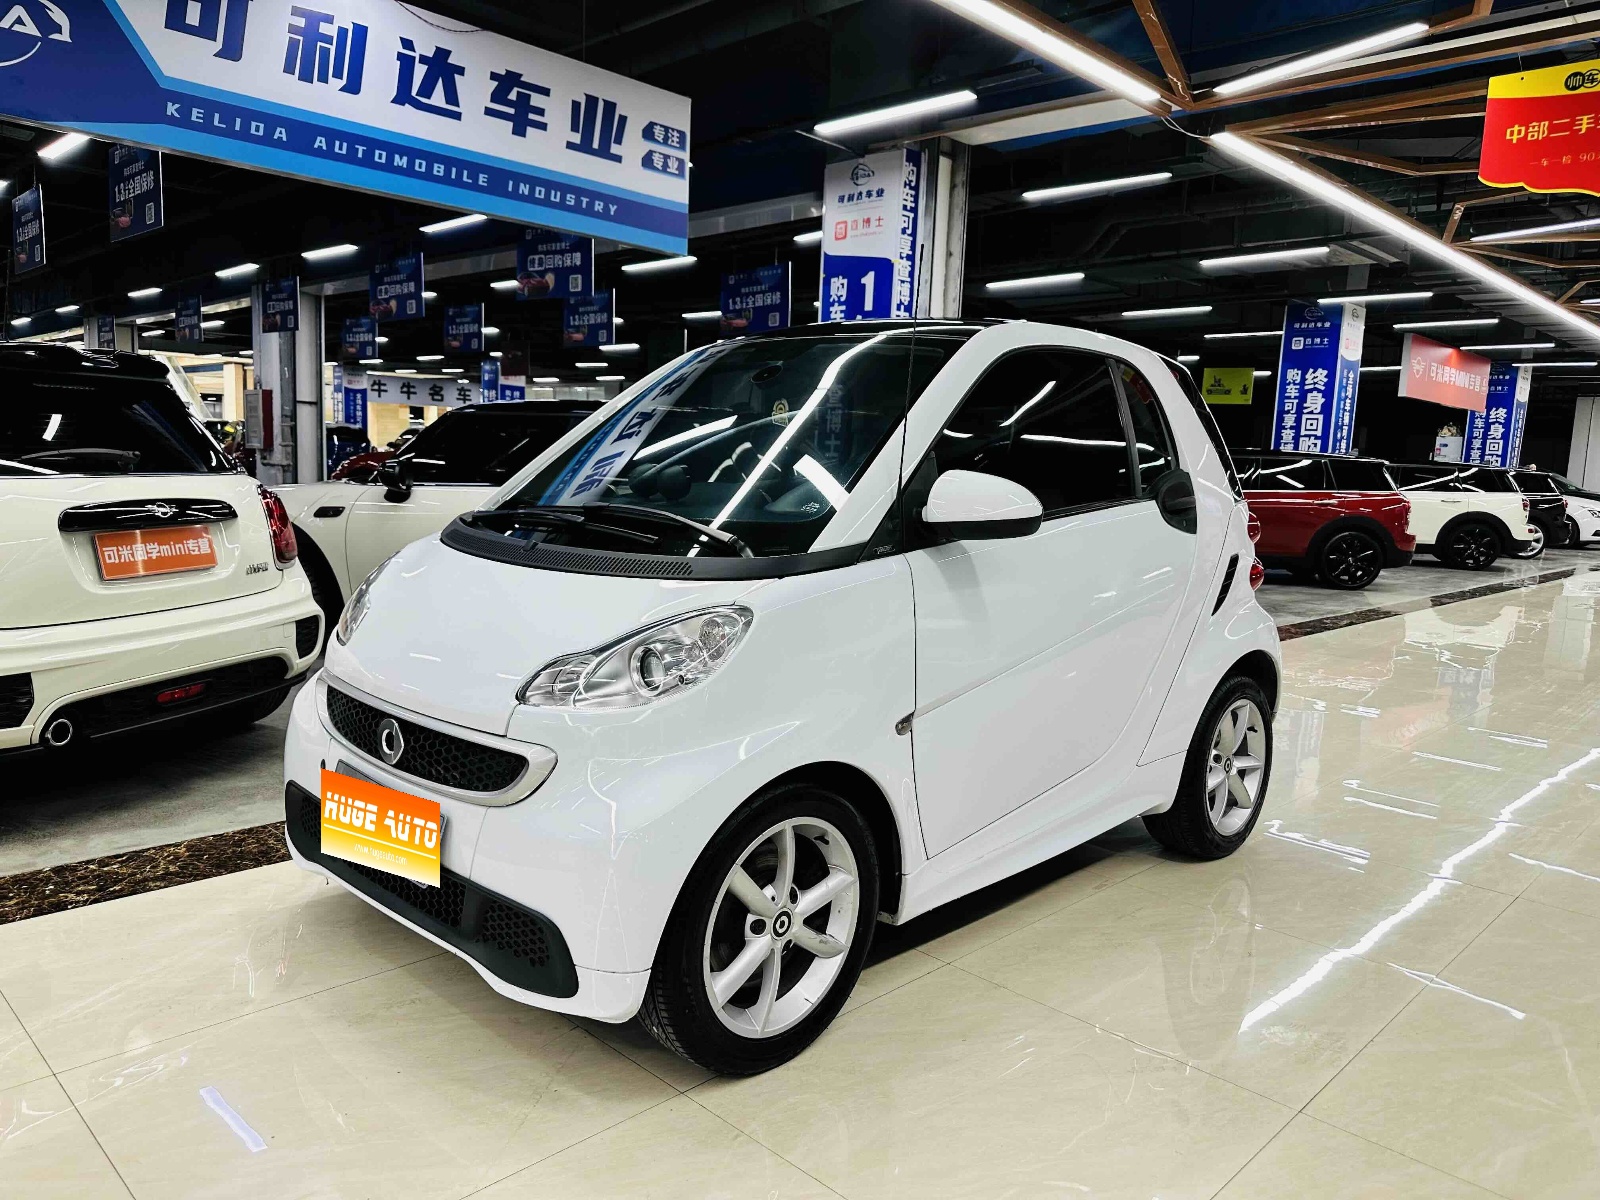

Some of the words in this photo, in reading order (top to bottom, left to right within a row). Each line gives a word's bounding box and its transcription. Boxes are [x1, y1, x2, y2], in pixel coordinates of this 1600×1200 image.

[164, 0, 627, 164] 可利达车业
[652, 124, 680, 147] 专注
[1506, 114, 1600, 143] 中部二手
[166, 101, 287, 142] KELIDA
[314, 136, 489, 187] AUTOMOBILE
[507, 180, 618, 215] INDUSTRY
[651, 151, 680, 175] 专业
[1579, 152, 1600, 163] 90
[838, 187, 885, 204] 可利达车业
[370, 379, 473, 404] 牛牛名车
